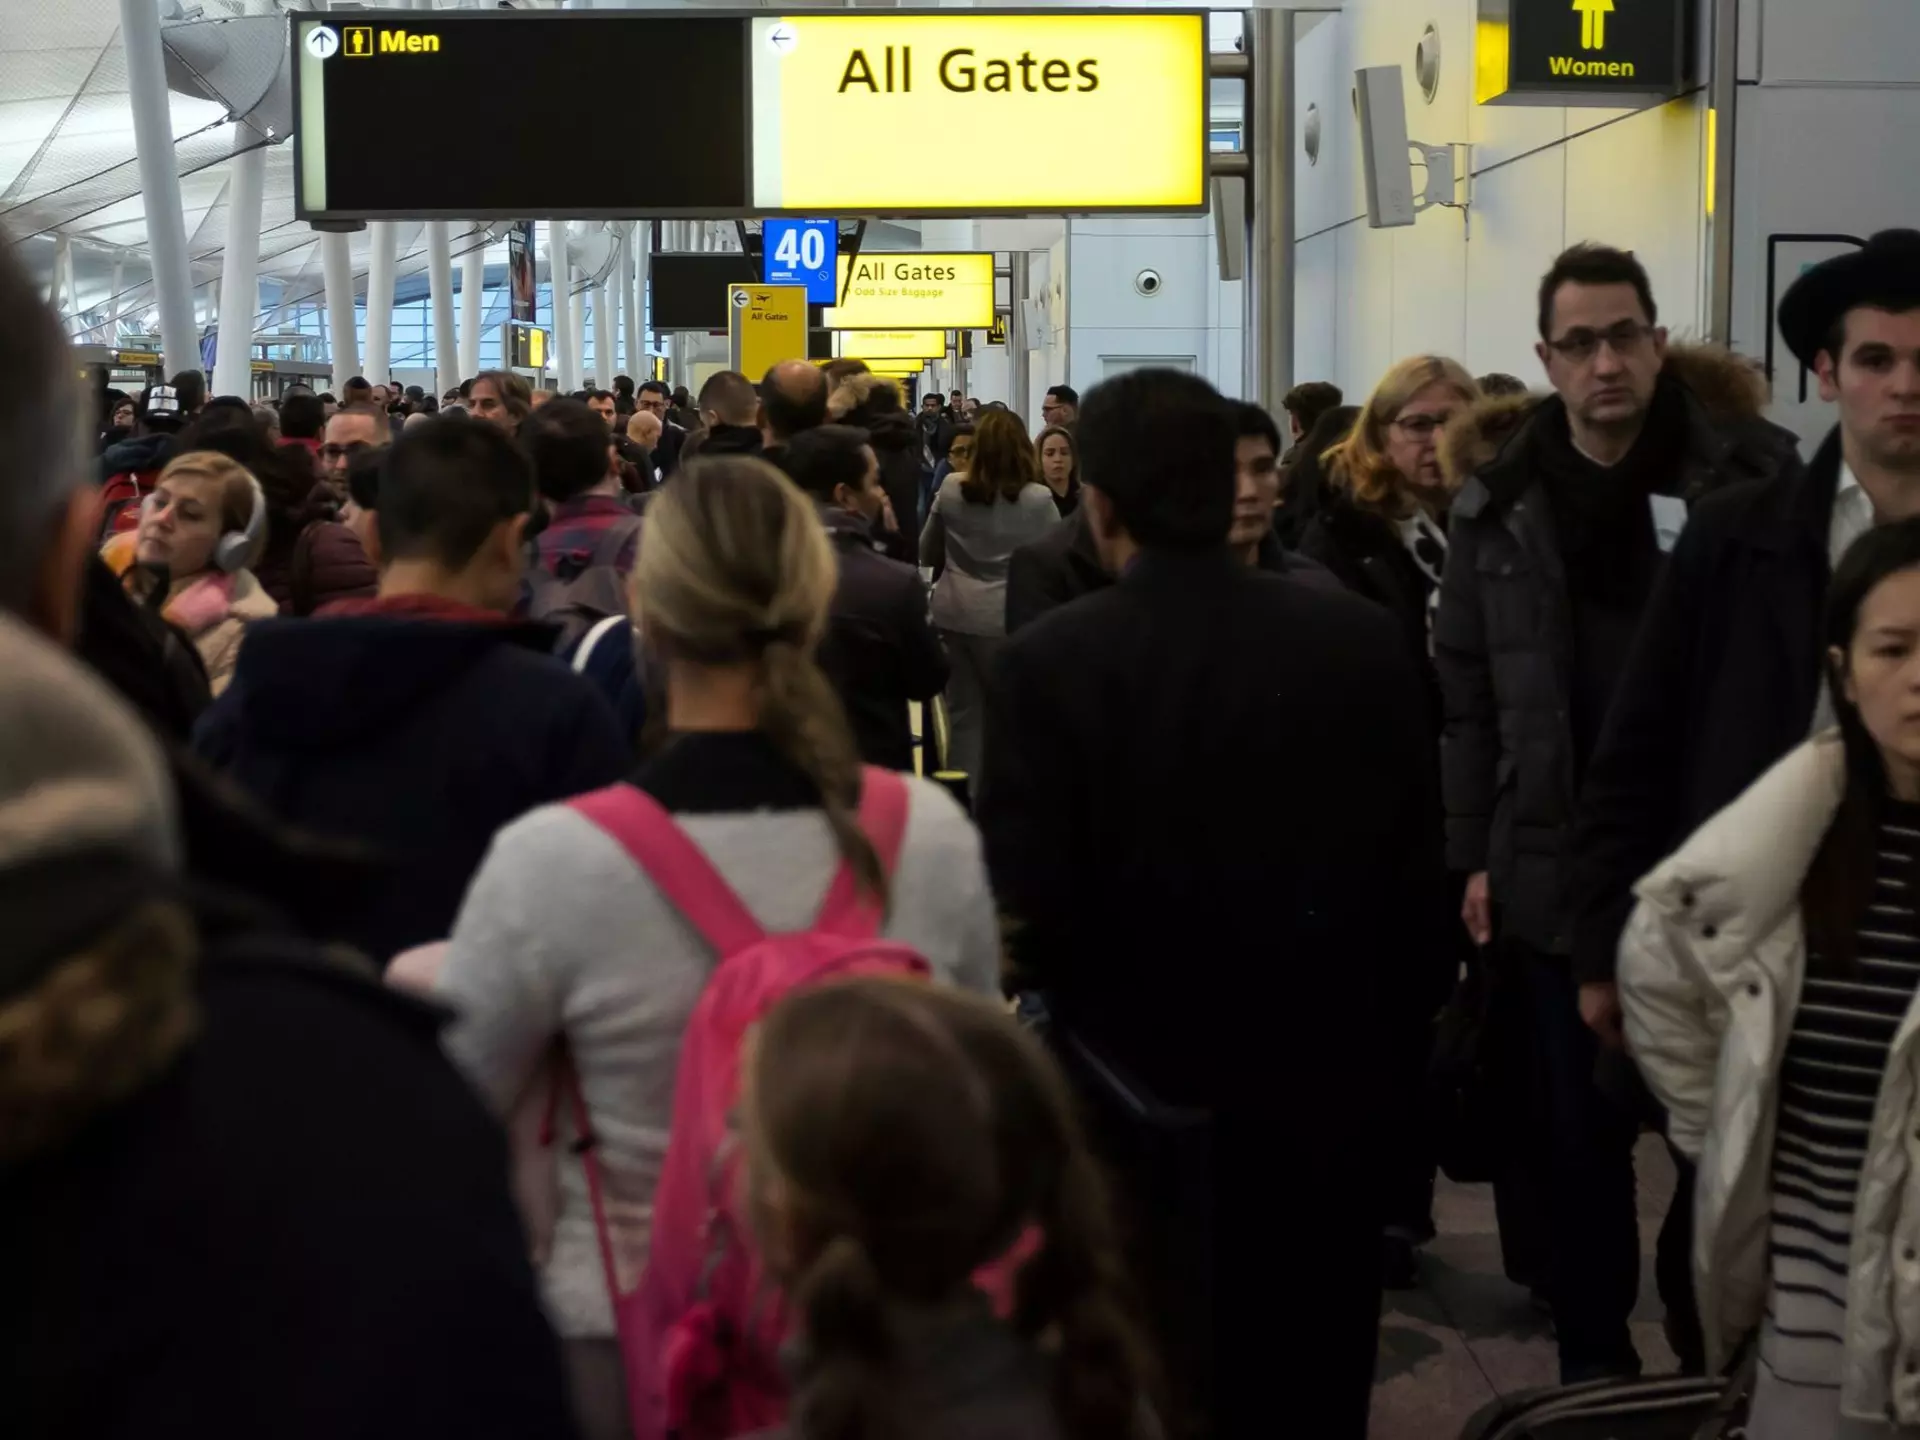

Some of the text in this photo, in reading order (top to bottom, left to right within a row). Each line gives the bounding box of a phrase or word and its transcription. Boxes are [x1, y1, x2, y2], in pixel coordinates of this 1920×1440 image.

[380, 30, 440, 53] Men
[838, 46, 1099, 93] All Gates
[1549, 56, 1634, 76] Women
[774, 228, 825, 270] 40
[856, 262, 956, 281] All Gates
[854, 287, 944, 298] Odd Size Baggage
[751, 312, 788, 321] All Gates
